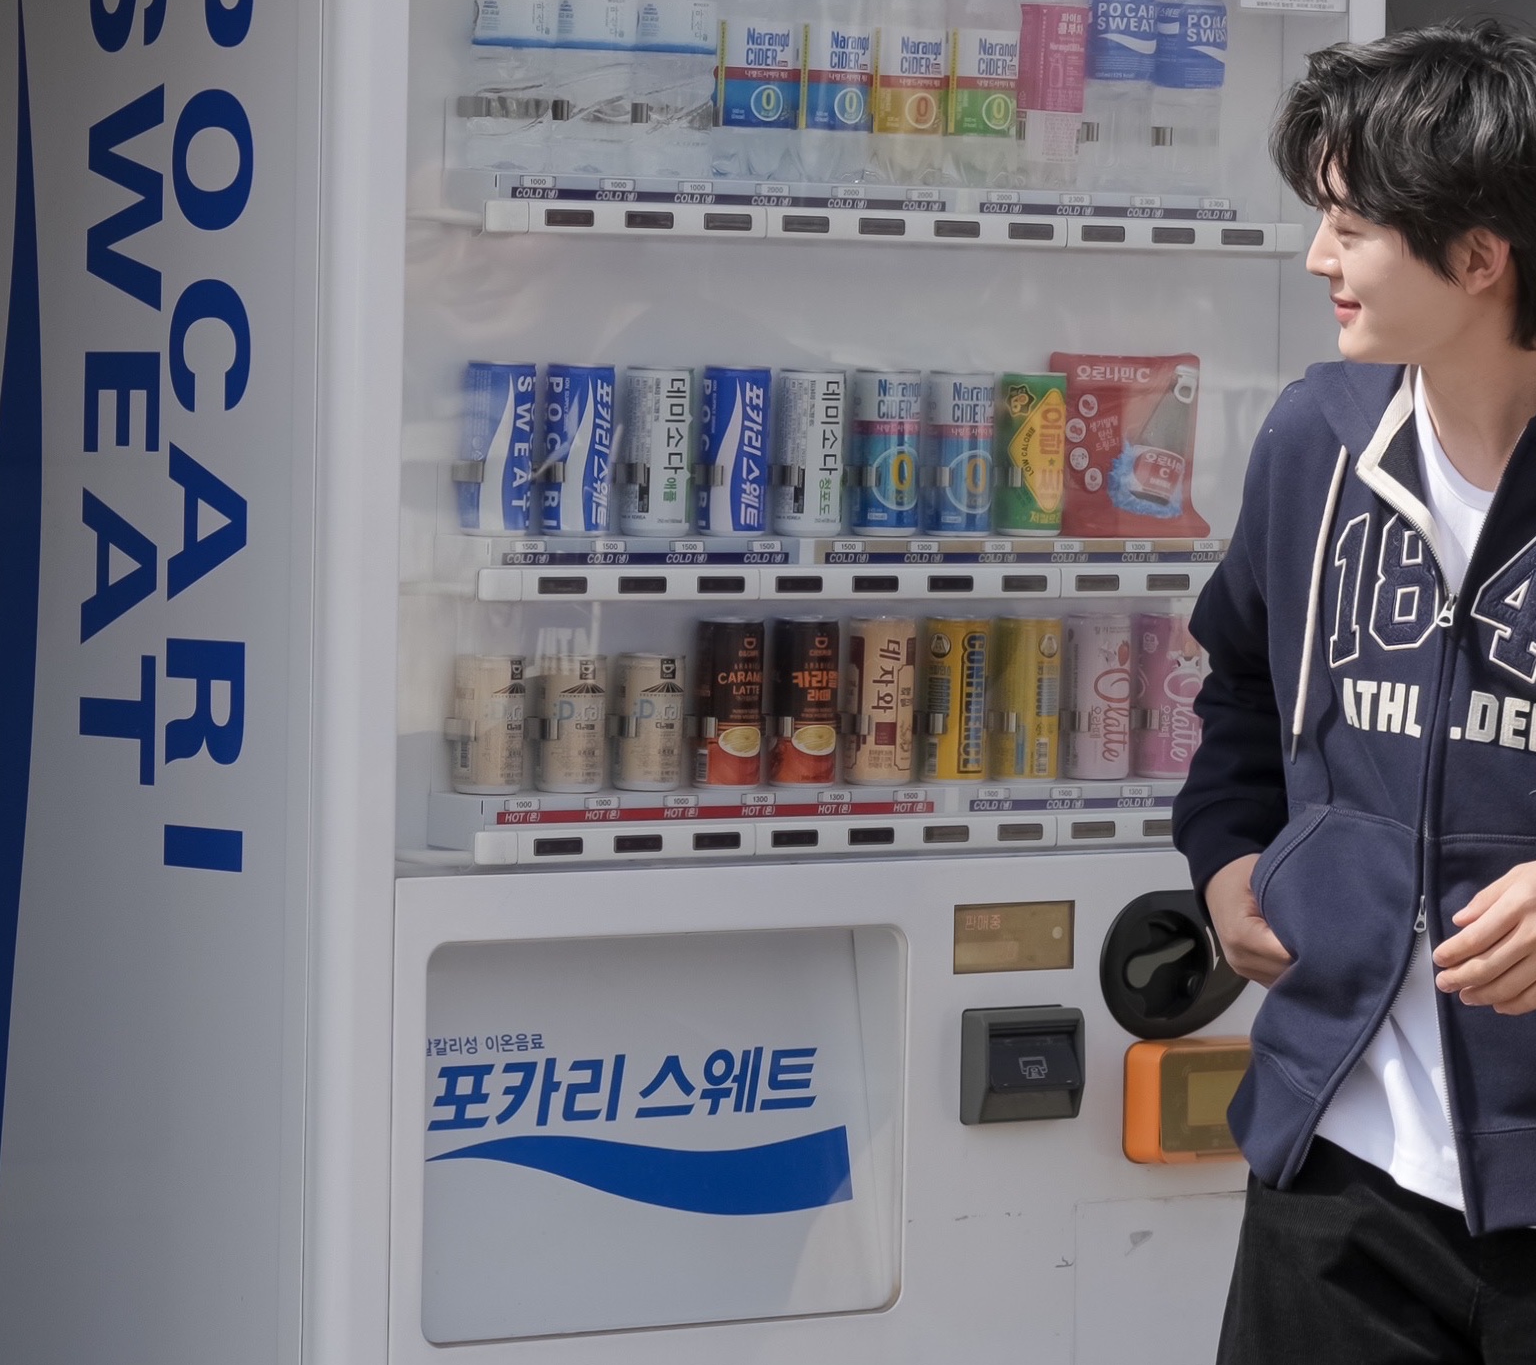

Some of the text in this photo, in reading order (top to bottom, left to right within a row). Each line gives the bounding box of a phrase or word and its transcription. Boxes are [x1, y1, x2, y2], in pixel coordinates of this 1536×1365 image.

[1097, 17, 1155, 33] SWEAT
[516, 188, 542, 198] COLD
[595, 190, 622, 200] COLD
[674, 194, 700, 203] COLD
[751, 196, 777, 205] COLD
[827, 198, 853, 208] COLD
[902, 201, 927, 210] COLD
[983, 204, 1008, 213] COLD
[1056, 206, 1080, 215] COLD
[1127, 208, 1150, 217] COLD
[1196, 210, 1220, 219] COLD
[1076, 365, 1150, 383] 오로나민C
[878, 379, 920, 403] Narang
[952, 382, 994, 407] Narang
[663, 378, 686, 475] 데미소다
[819, 381, 840, 476] 데미소다
[511, 375, 533, 512] SWEAT
[544, 376, 563, 526] POCRI
[591, 378, 612, 527] 포카리 스웨트
[698, 378, 713, 526] POCRI
[740, 381, 763, 528] 포카리 스웨트
[1021, 426, 1036, 477] LOW CALORIE
[891, 452, 913, 491] 0
[966, 458, 986, 495] 0
[1159, 468, 1170, 478] C
[663, 477, 677, 502] 애플
[819, 477, 831, 516] 청포도
[522, 542, 539, 551] 1500
[602, 542, 618, 551] 1500
[681, 543, 697, 551] 1500
[758, 542, 775, 550] 1500
[990, 543, 1005, 551] 1300
[506, 554, 533, 563] COLD
[587, 553, 613, 563] COLD
[666, 553, 692, 563] COLD
[743, 553, 769, 563] COLD
[829, 553, 855, 563] COLD
[904, 553, 929, 563] COLD
[978, 553, 1002, 563] COLD
[1051, 553, 1075, 563] COLD
[1121, 553, 1145, 563] COLD
[1191, 552, 1215, 561] COLD
[718, 671, 763, 684] CARAM
[792, 671, 838, 688] 카라멜
[871, 639, 901, 713] 데자와
[733, 686, 760, 695] LATTE
[807, 689, 831, 701] 라떼
[962, 634, 986, 770] CONFIDENCE
[829, 793, 845, 801] 1300
[903, 792, 918, 800] 1500
[1057, 789, 1072, 797] 1500
[1128, 788, 1143, 796] 1300
[515, 800, 532, 808] 1000
[595, 799, 611, 807] 1000
[673, 797, 689, 805] 1000
[752, 795, 768, 803] 1300
[1046, 799, 1071, 809] COLD
[1117, 798, 1142, 808] COLD
[817, 804, 837, 814] HOT
[893, 803, 912, 813] HOT
[973, 800, 998, 810] COLD
[585, 810, 605, 820] HOT
[664, 808, 684, 818] HOT
[741, 806, 761, 816] HOT
[505, 812, 525, 822] HOT
[964, 914, 1001, 931] 판매중
[485, 1033, 545, 1054] 이온음료
[427, 1046, 818, 1131] 포카리 스웨트
